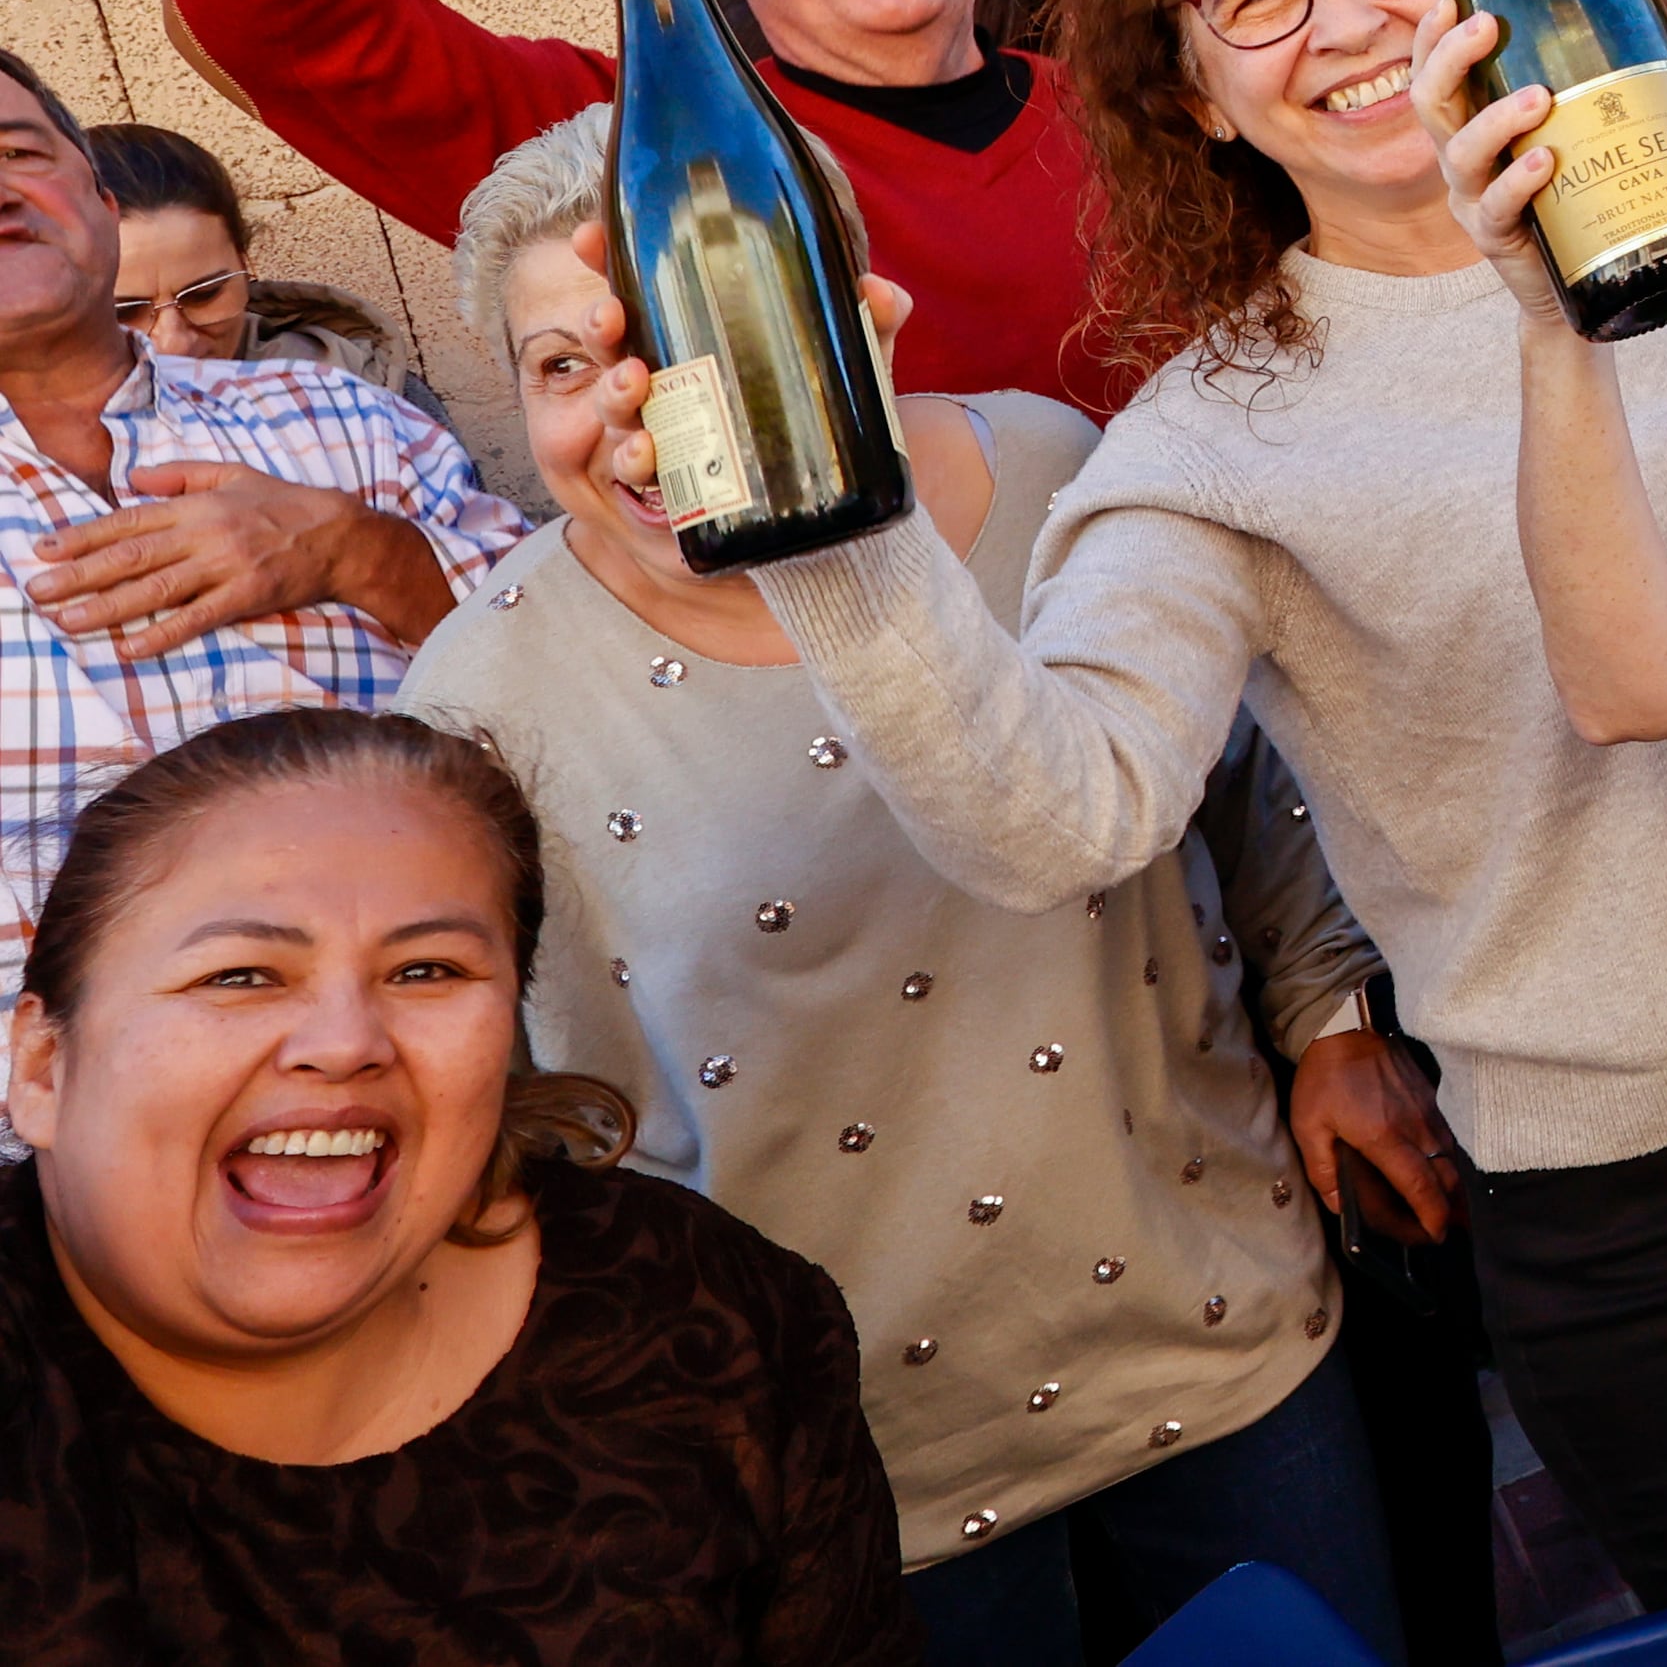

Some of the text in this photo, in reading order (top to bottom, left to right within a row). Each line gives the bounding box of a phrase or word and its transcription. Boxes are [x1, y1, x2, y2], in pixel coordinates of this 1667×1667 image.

[1550, 143, 1634, 205] JAUME
[1618, 168, 1664, 191] CAVA
[1596, 198, 1637, 225] BRUT
[1603, 209, 1667, 241] TRADITIONAL
